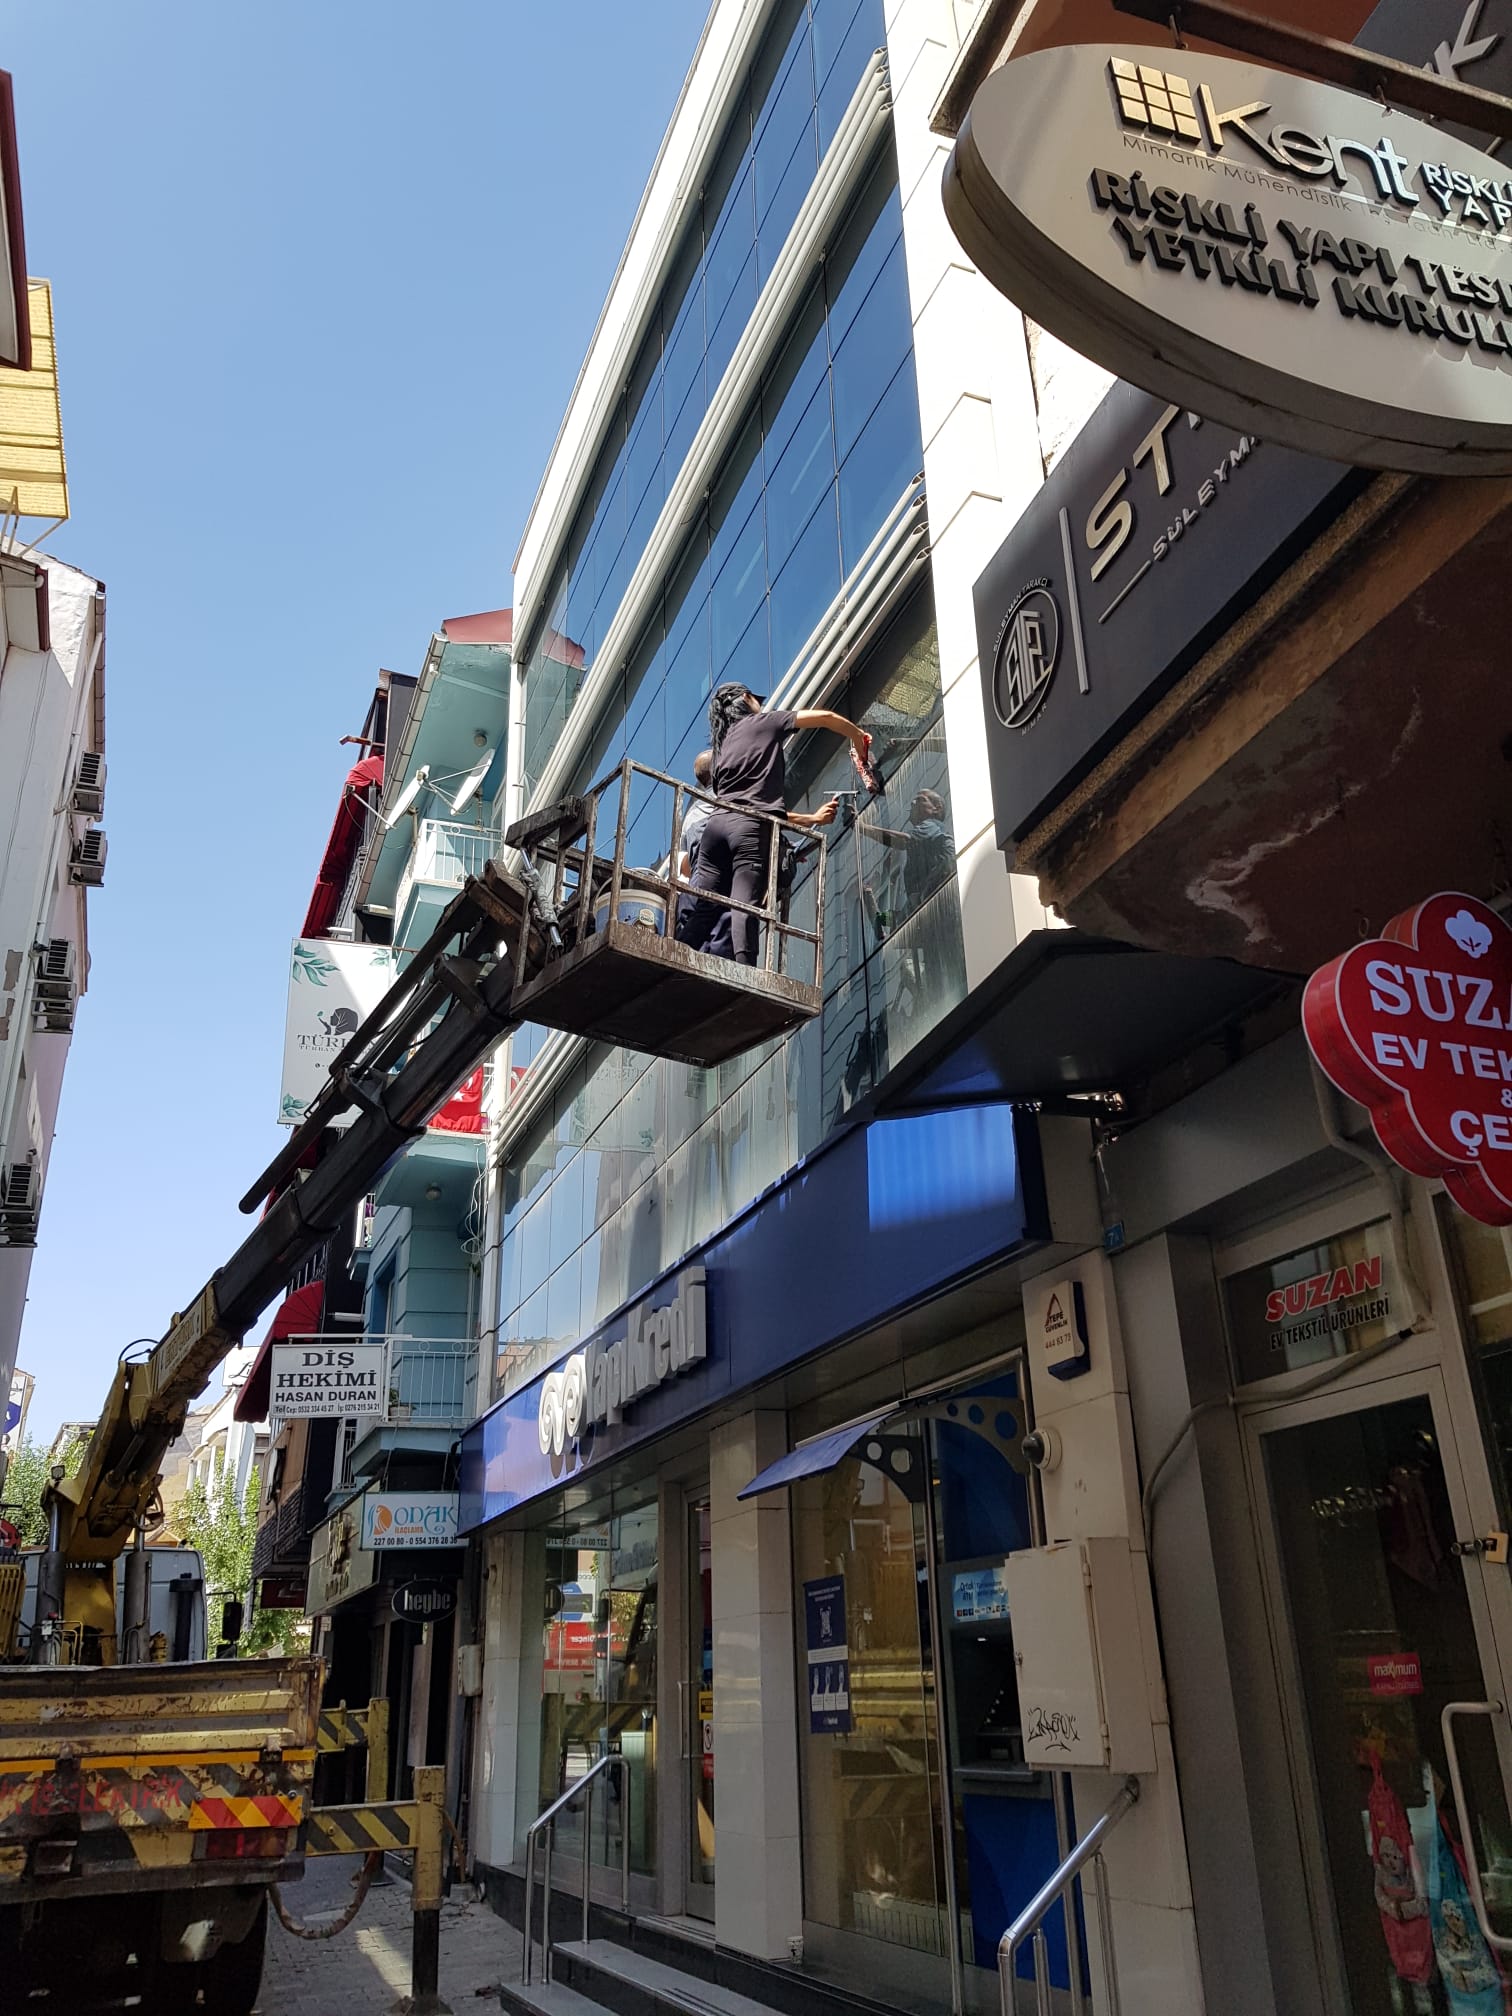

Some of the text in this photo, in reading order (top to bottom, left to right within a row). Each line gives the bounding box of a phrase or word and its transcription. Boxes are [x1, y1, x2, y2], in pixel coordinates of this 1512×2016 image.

[1123, 135, 1218, 174] Mimarlık
[1224, 164, 1352, 212] Mühendislik
[1197, 82, 1420, 207] Kent
[1091, 167, 1269, 253] RİSKLİ
[1277, 218, 1399, 285] YAPI
[1112, 215, 1512, 359] YETKİLİ KURUL
[1085, 404, 1201, 583] ST
[1152, 434, 1258, 562] SÜLEYM
[1365, 959, 1512, 1031] SUZ
[1371, 1031, 1429, 1070] EV
[1450, 1110, 1512, 1158] ÇE
[1264, 1255, 1382, 1323] SUZAN
[1271, 1291, 1390, 1351] EV TEKSTİL ÜRÜNLERİ
[276, 1369, 377, 1388] HEKİMİ
[302, 1349, 355, 1369] DİŞ
[275, 1390, 377, 1402] HASAN DURAN
[374, 1537, 385, 1546] 227
[404, 1589, 451, 1614] heybe
